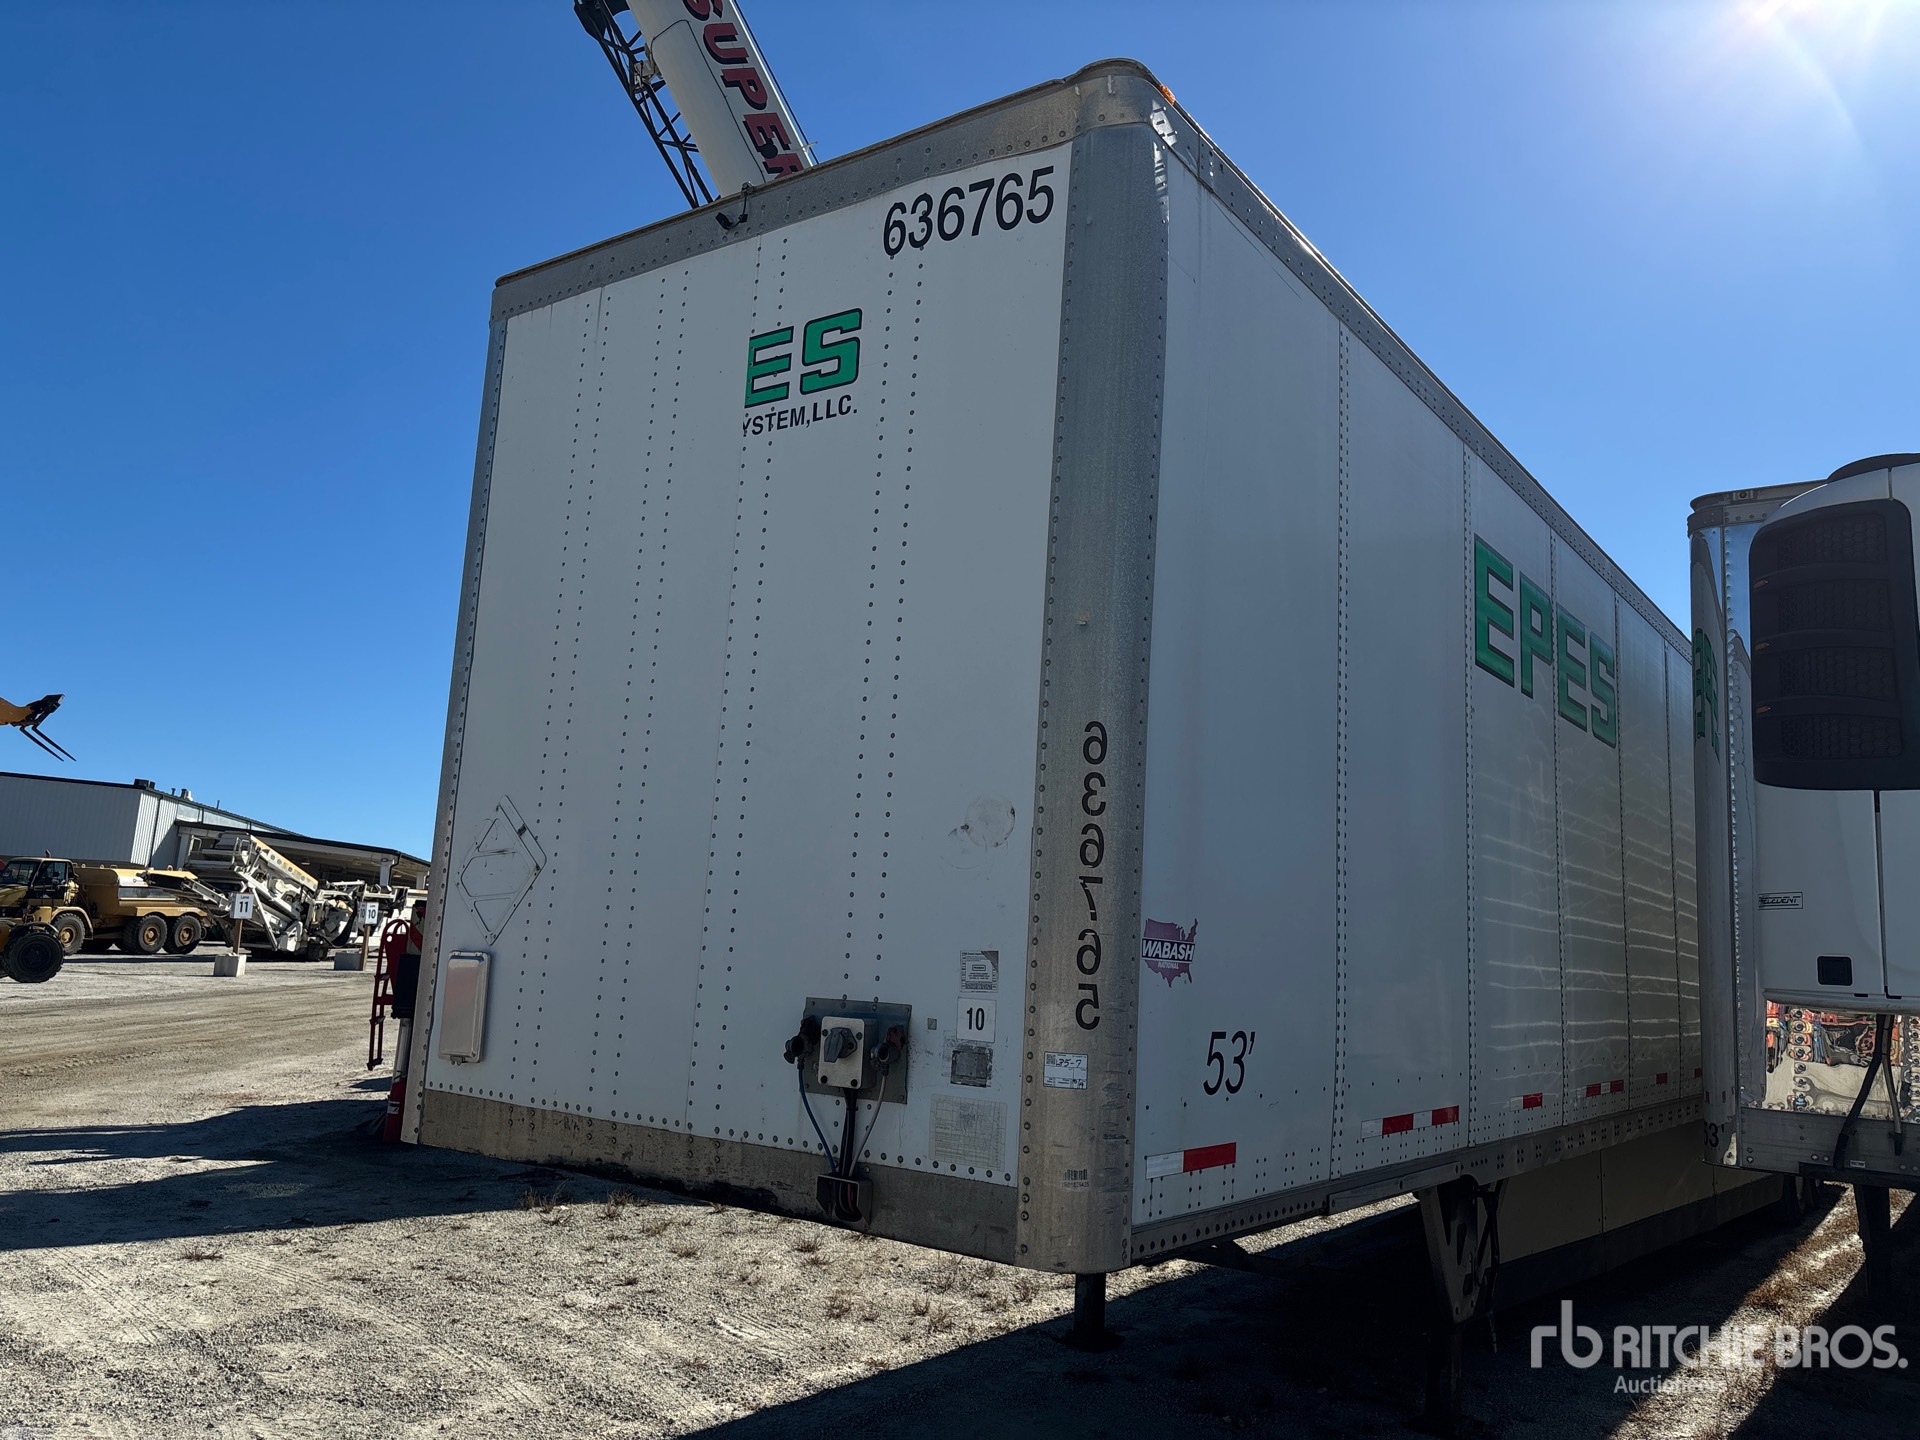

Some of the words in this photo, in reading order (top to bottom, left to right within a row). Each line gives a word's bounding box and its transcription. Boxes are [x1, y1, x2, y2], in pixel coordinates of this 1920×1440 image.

[883, 165, 1054, 257] 636765
[744, 308, 863, 409] ES
[1473, 532, 1617, 749] EPES
[239, 901, 249, 913] 11
[368, 909, 377, 919] 10
[1142, 939, 1195, 961] WABASH
[1157, 961, 1180, 970] NATIONAL
[966, 1007, 985, 1031] 10
[1203, 1031, 1256, 1096] 53'
